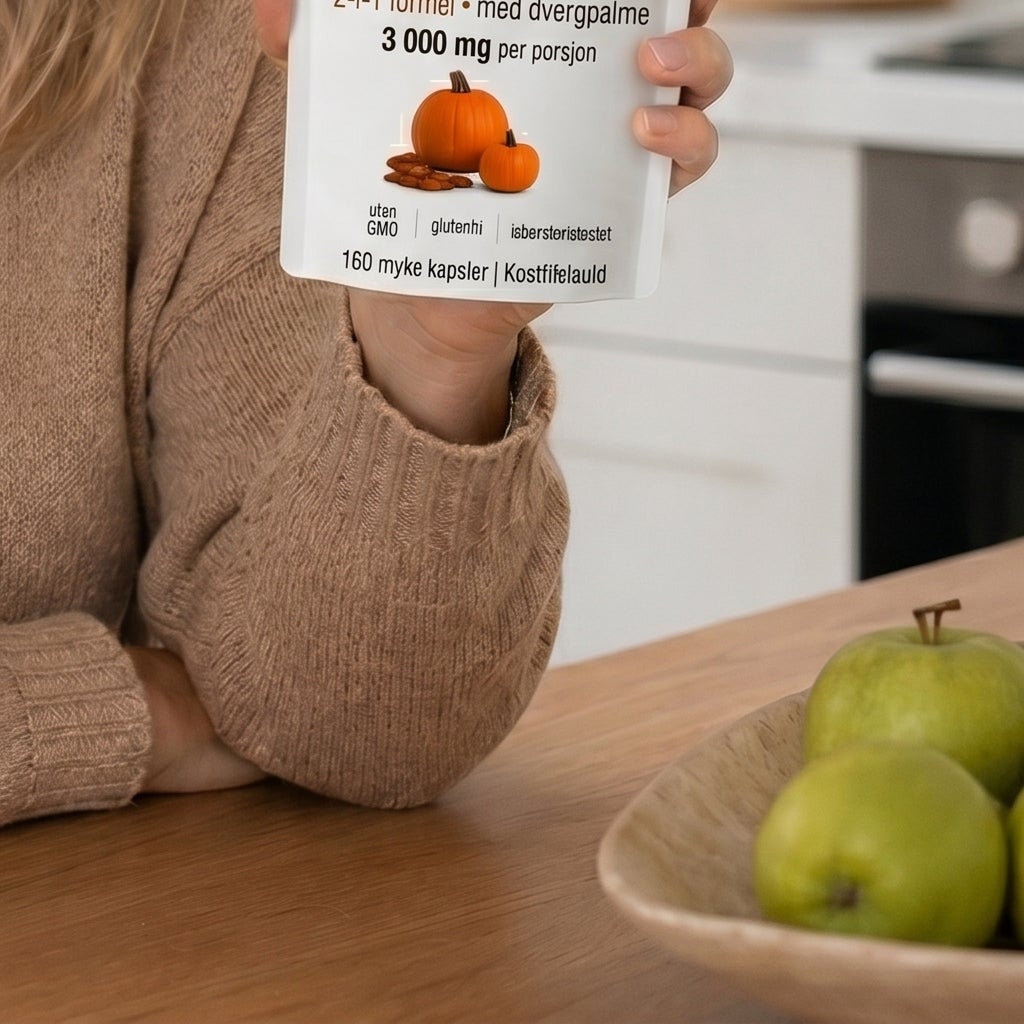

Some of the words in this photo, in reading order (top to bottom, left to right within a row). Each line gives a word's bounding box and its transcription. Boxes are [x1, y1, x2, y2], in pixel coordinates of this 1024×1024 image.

[381, 25, 397, 52] 3
[403, 27, 448, 56] 000
[454, 36, 492, 65] mg
[497, 42, 528, 64] per
[531, 40, 597, 67] porsjon
[369, 202, 397, 219] uten
[366, 219, 399, 238] GMO
[430, 216, 484, 237] glutenhi
[342, 249, 373, 272] 160
[378, 255, 423, 280] myke
[427, 257, 490, 284] kapsler
